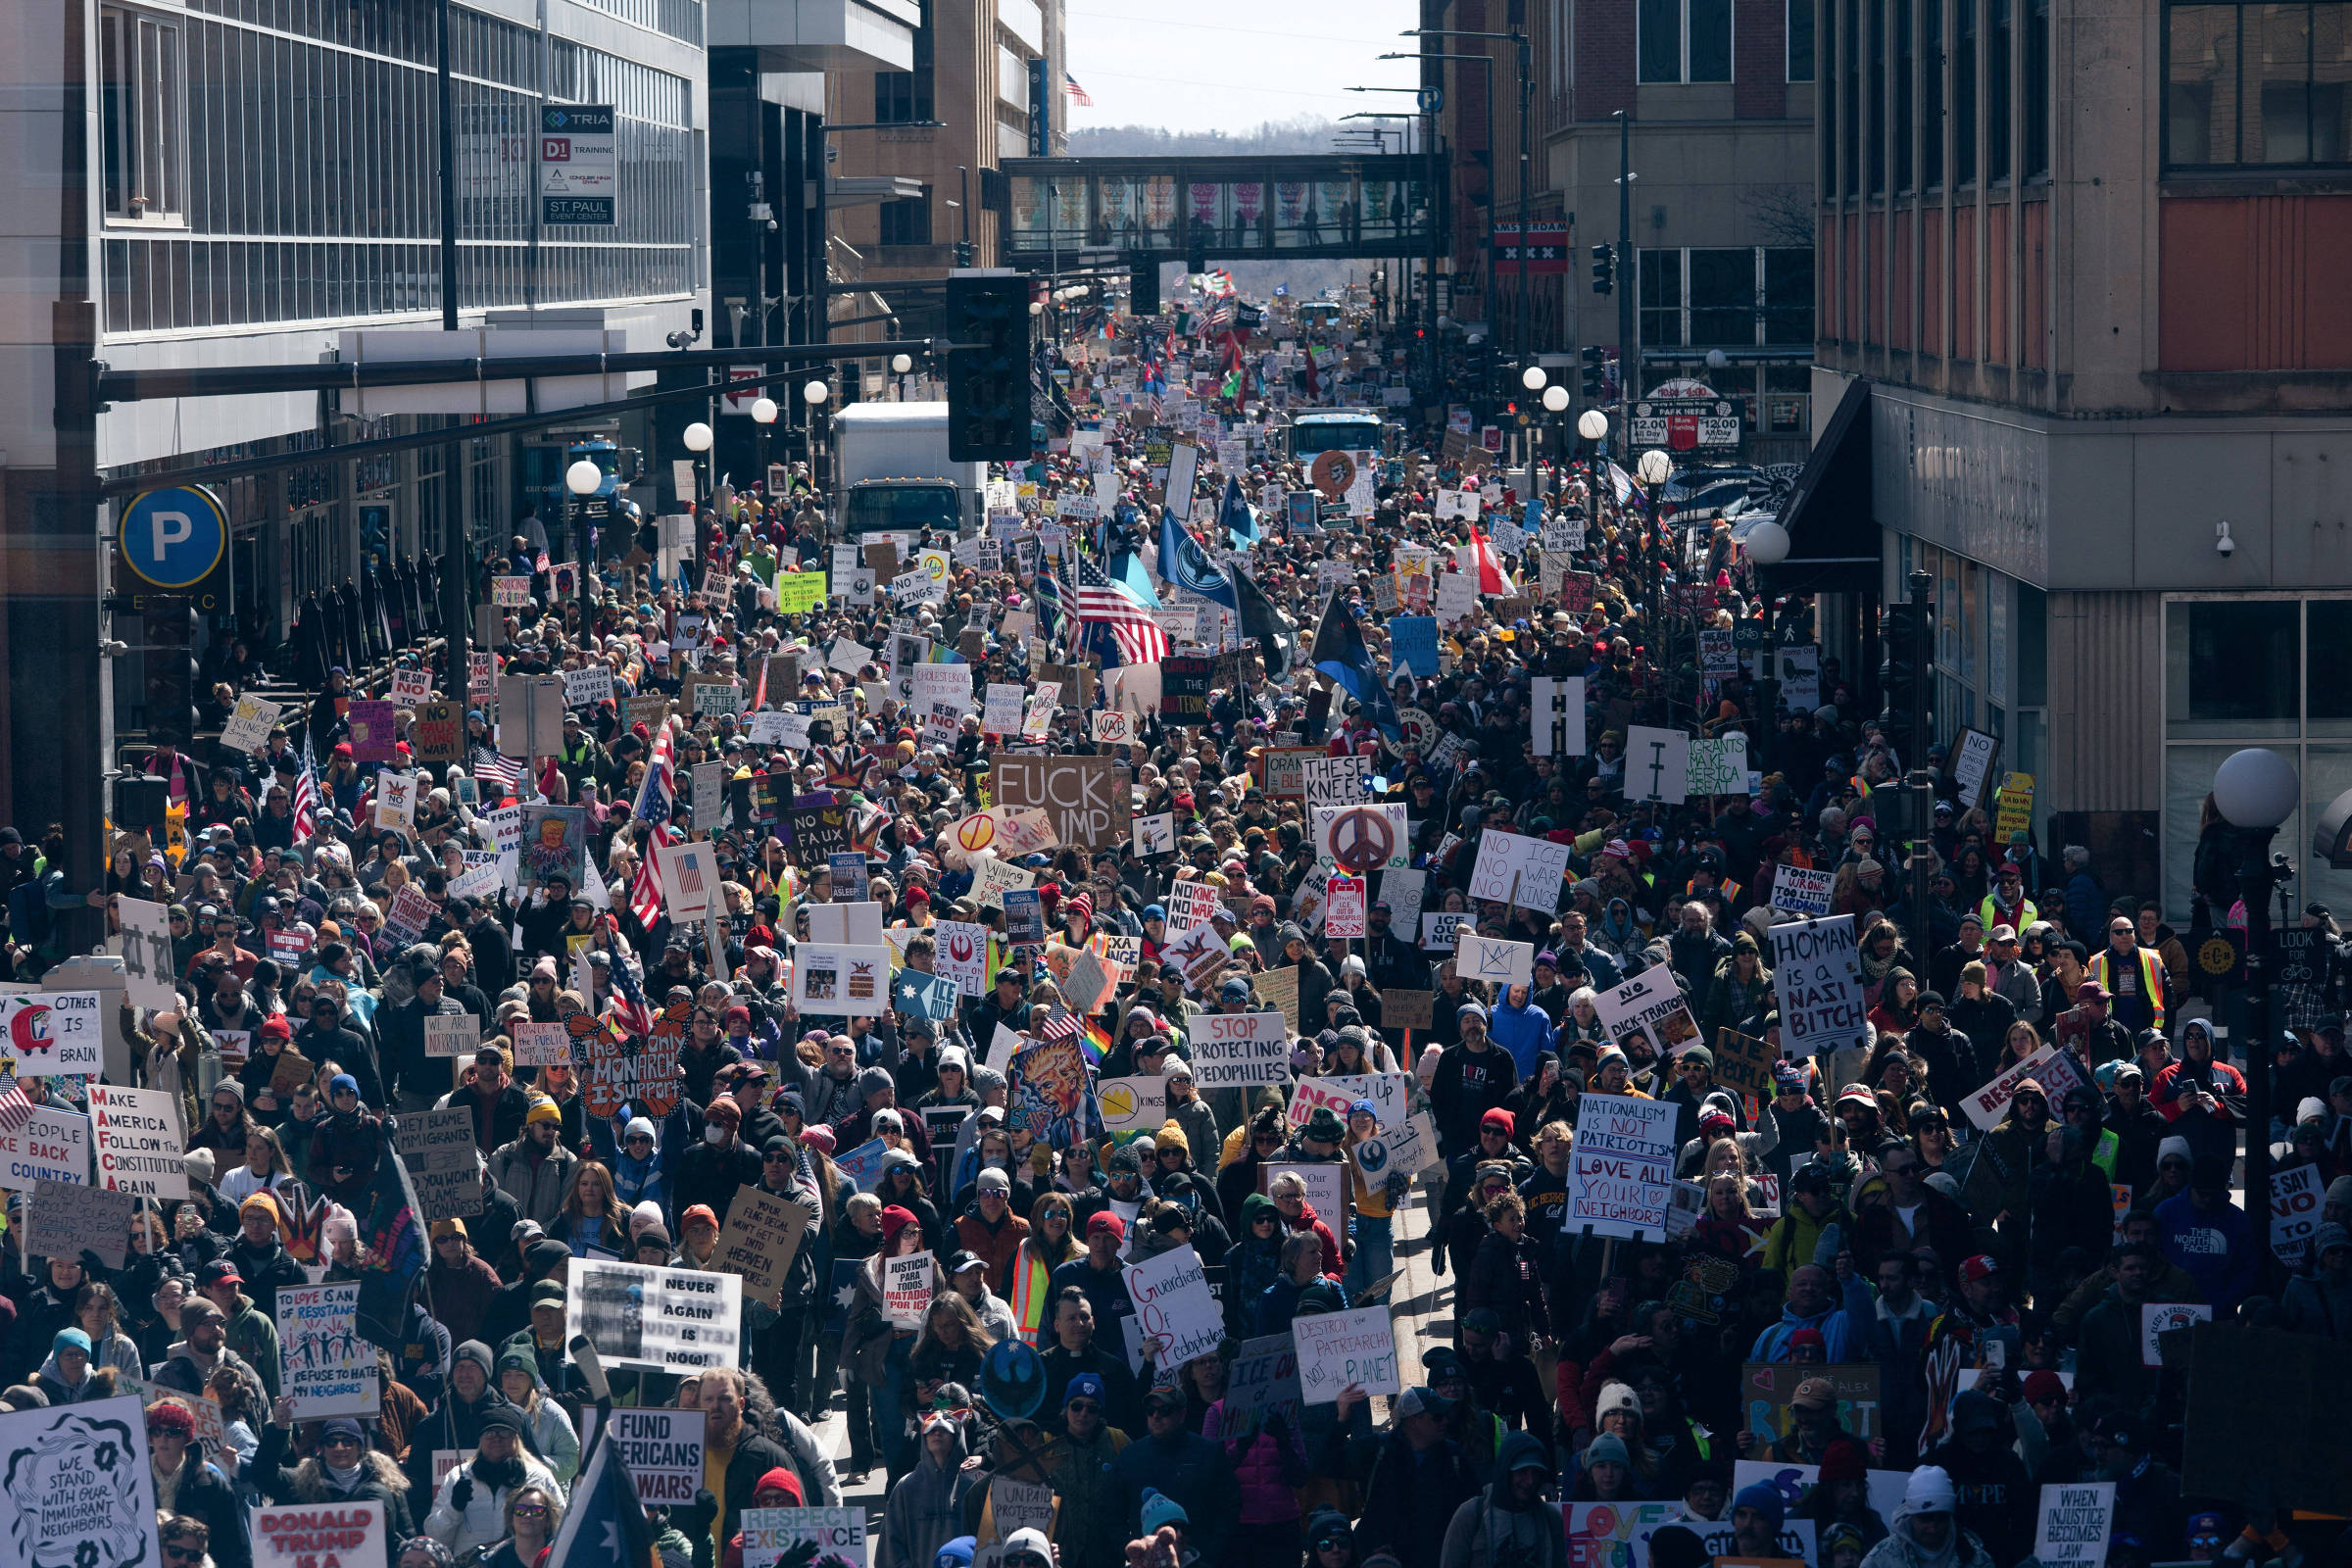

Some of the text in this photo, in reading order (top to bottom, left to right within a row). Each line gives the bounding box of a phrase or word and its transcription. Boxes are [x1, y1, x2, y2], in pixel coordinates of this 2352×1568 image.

[571, 115, 610, 124] TRIA
[547, 142, 566, 157] D1
[551, 202, 607, 212] ST. PAUL
[152, 512, 192, 561] P
[710, 573, 725, 582] NO
[896, 578, 911, 589] NO
[707, 580, 727, 594] WAR
[900, 588, 933, 604] KINGS
[398, 670, 427, 685] WE SAY
[570, 669, 609, 682] FASCISM
[916, 670, 970, 684] CHOLESTEROL
[397, 682, 425, 695] NO
[572, 681, 609, 693] SPARES
[1185, 679, 1203, 690] THE
[704, 696, 735, 706] BETTER
[932, 702, 957, 717] WE SAY
[987, 698, 1022, 708] IMMIGRANTS
[233, 716, 268, 737] KINGS
[420, 720, 457, 734] FAUX
[930, 714, 956, 729] NO
[1096, 717, 1126, 735] WAR
[934, 729, 948, 740] TO
[1968, 736, 1989, 751] NO
[1305, 757, 1367, 777] THESE
[999, 762, 1110, 808] FUCK
[1307, 777, 1370, 799] KNEES
[388, 795, 404, 805] NO
[795, 815, 815, 827] NO
[1387, 806, 1405, 820] MN
[799, 831, 845, 847] FAUX
[1485, 835, 1565, 862] NO ICE
[836, 858, 859, 867] WOKE,
[1388, 857, 1409, 867] USA
[1480, 858, 1559, 884] NO WAR
[1779, 864, 1833, 884] TOO MUCH
[833, 887, 859, 897] ASLEEP!
[1788, 876, 1826, 892] WRONG
[1474, 880, 1559, 911] NO KINGS
[1776, 887, 1833, 903] TOO LITTLE
[1172, 898, 1214, 918] NO WAR
[1775, 897, 1828, 914] CARDBOARD
[1168, 915, 1188, 930] NO
[1437, 914, 1465, 925] ICE
[1008, 923, 1035, 934] ASLEEP!
[273, 934, 312, 947] DICTATOR
[1777, 922, 1858, 964] HOMAN!
[2280, 932, 2314, 948] LOOK
[2289, 950, 2306, 959] FOR
[933, 977, 956, 1004] ICE
[1617, 982, 1645, 1001] NO
[55, 996, 96, 1010] OTHER
[65, 1017, 83, 1032] IS
[429, 1016, 468, 1030] WE ARE
[1611, 995, 1685, 1038] DICK-TRAITOR
[1789, 1001, 1864, 1037] BITCH
[516, 1024, 548, 1036] POWER
[1210, 1017, 1258, 1039] STOP
[425, 1032, 479, 1053] UNDERREACTING
[520, 1046, 557, 1055] NOT the
[1193, 1039, 1283, 1059] PROTECTING
[60, 1048, 96, 1062] BRAIN
[528, 1054, 558, 1064] PALACE
[593, 1054, 675, 1084] MONARCH
[1195, 1061, 1291, 1082] PEDOPHILES
[91, 1088, 138, 1108] MAKE
[1140, 1096, 1166, 1108] KINGS
[1376, 1082, 1394, 1105] Up
[1583, 1099, 1666, 1121] NATIONALISM
[97, 1110, 168, 1131] AMERICA
[428, 1113, 466, 1130] BLAME
[1588, 1117, 1652, 1138] IS NOT
[99, 1131, 178, 1153] FOLLOW The
[1581, 1130, 1677, 1157] PATRIOTISM
[29, 1142, 70, 1163] BACK
[102, 1153, 186, 1174] CONSTITUTION
[1578, 1157, 1672, 1186] LOVE ALL
[11, 1162, 81, 1185] COUNTRY
[1307, 1173, 1327, 1183] Our
[107, 1175, 156, 1195] AGAIN
[1583, 1179, 1641, 1205] YOUR
[417, 1187, 461, 1205] BLAME
[1324, 1207, 1333, 1216] to
[1577, 1200, 1663, 1224] NEIGHBORS
[2280, 1221, 2312, 1239] TO
[2175, 1235, 2210, 1244] NORTH
[2183, 1245, 2209, 1253] FACE
[889, 1259, 931, 1275] JUSTICIA
[899, 1270, 922, 1283] PARA
[664, 1277, 715, 1295] NEVER
[896, 1279, 924, 1293] TODOS
[278, 1290, 353, 1305] TO LOVE IS AN
[884, 1287, 932, 1303] MATADOS
[663, 1303, 713, 1321] AGAIN
[889, 1298, 930, 1312] POR ICE
[680, 1328, 697, 1343] IS
[1298, 1315, 1366, 1341] DESTROY the
[1315, 1332, 1391, 1357] PATRIARCHY
[665, 1349, 710, 1369] NOW!
[1330, 1352, 1394, 1388] the PLANET
[292, 1383, 362, 1398] MY NEIGHBORS
[618, 1414, 671, 1440] FUND
[58, 1456, 84, 1472] WE
[49, 1471, 96, 1490] STAND
[636, 1474, 695, 1500] WARS
[42, 1488, 111, 1506] WITH OUR
[1004, 1487, 1054, 1504] UNPAID
[2060, 1489, 2098, 1506] WHEN
[40, 1500, 114, 1521] IMMIGRANT
[746, 1506, 855, 1529] RESPECT
[2047, 1507, 2105, 1525] INJUSTICE
[39, 1514, 114, 1539] NEIGHBORS
[260, 1509, 373, 1534] DONALD
[270, 1531, 367, 1551] TRUMP
[2047, 1525, 2102, 1543] BECOMES
[2057, 1544, 2082, 1559] LAW
